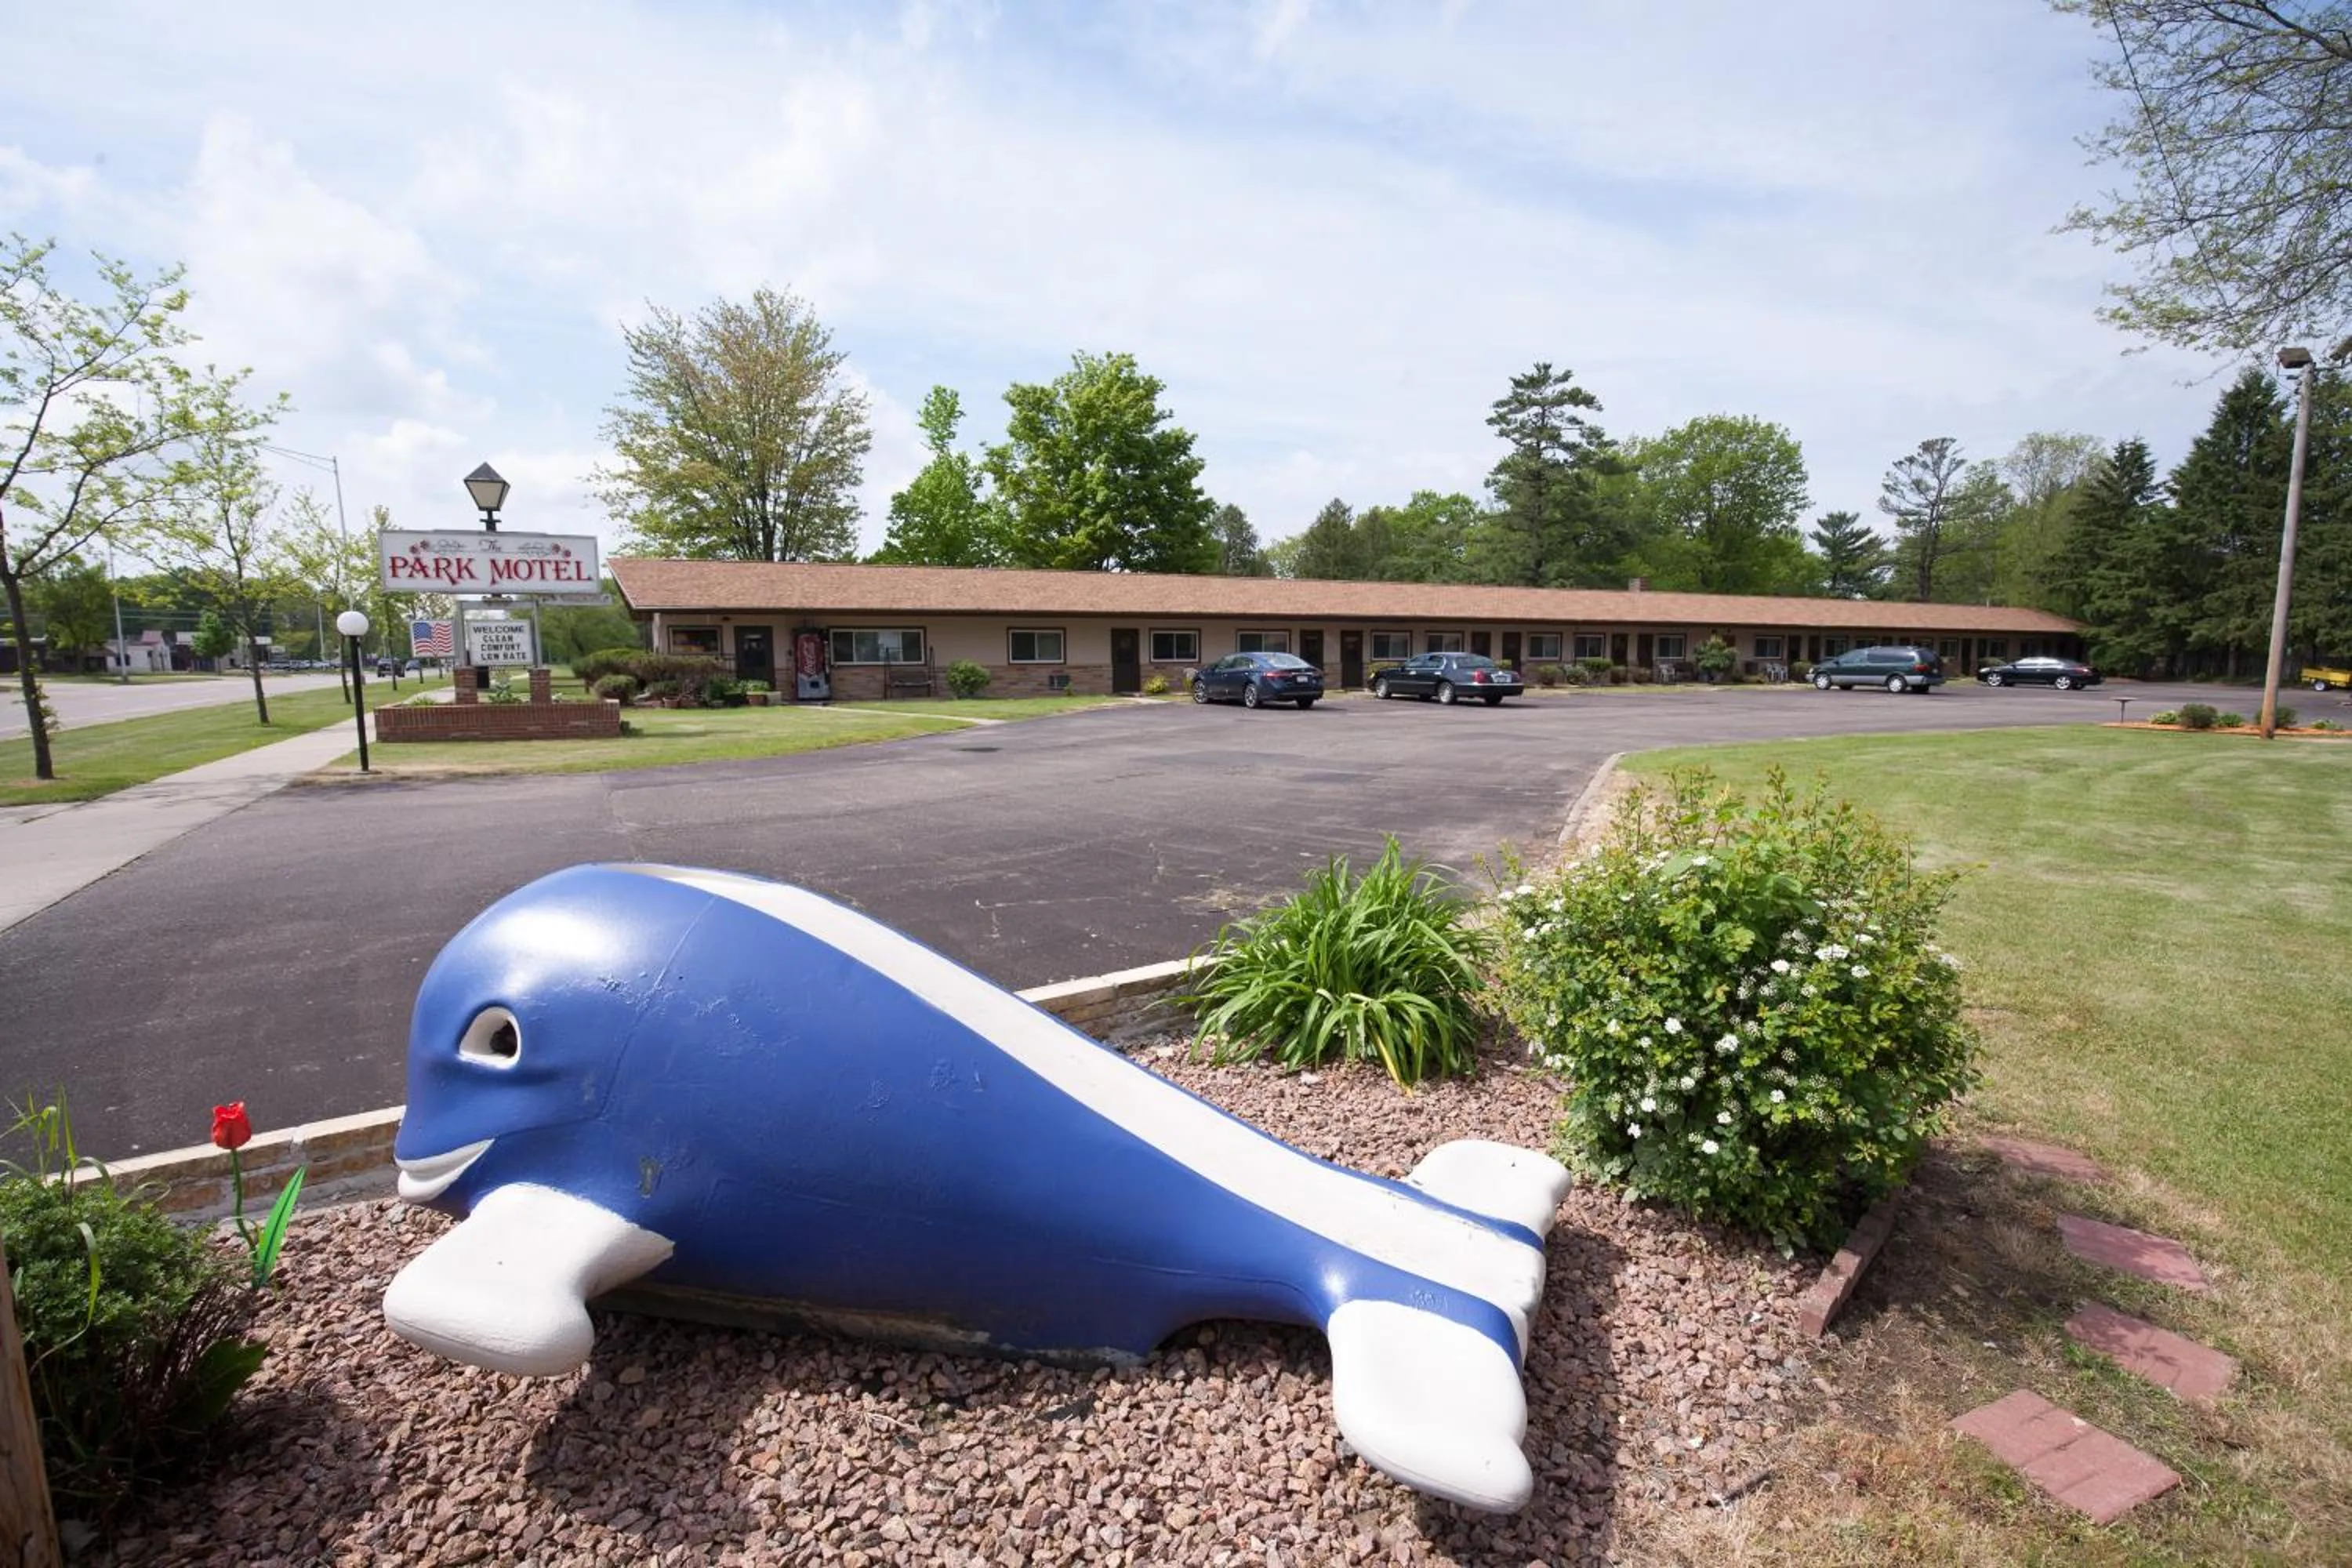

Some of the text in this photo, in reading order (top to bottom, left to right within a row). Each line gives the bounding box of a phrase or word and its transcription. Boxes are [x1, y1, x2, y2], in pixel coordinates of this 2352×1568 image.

[389, 555, 593, 586] PARK MOTEL
[473, 625, 524, 633] WELCOME
[482, 634, 514, 643] CLEAN
[503, 652, 526, 660] RATE
